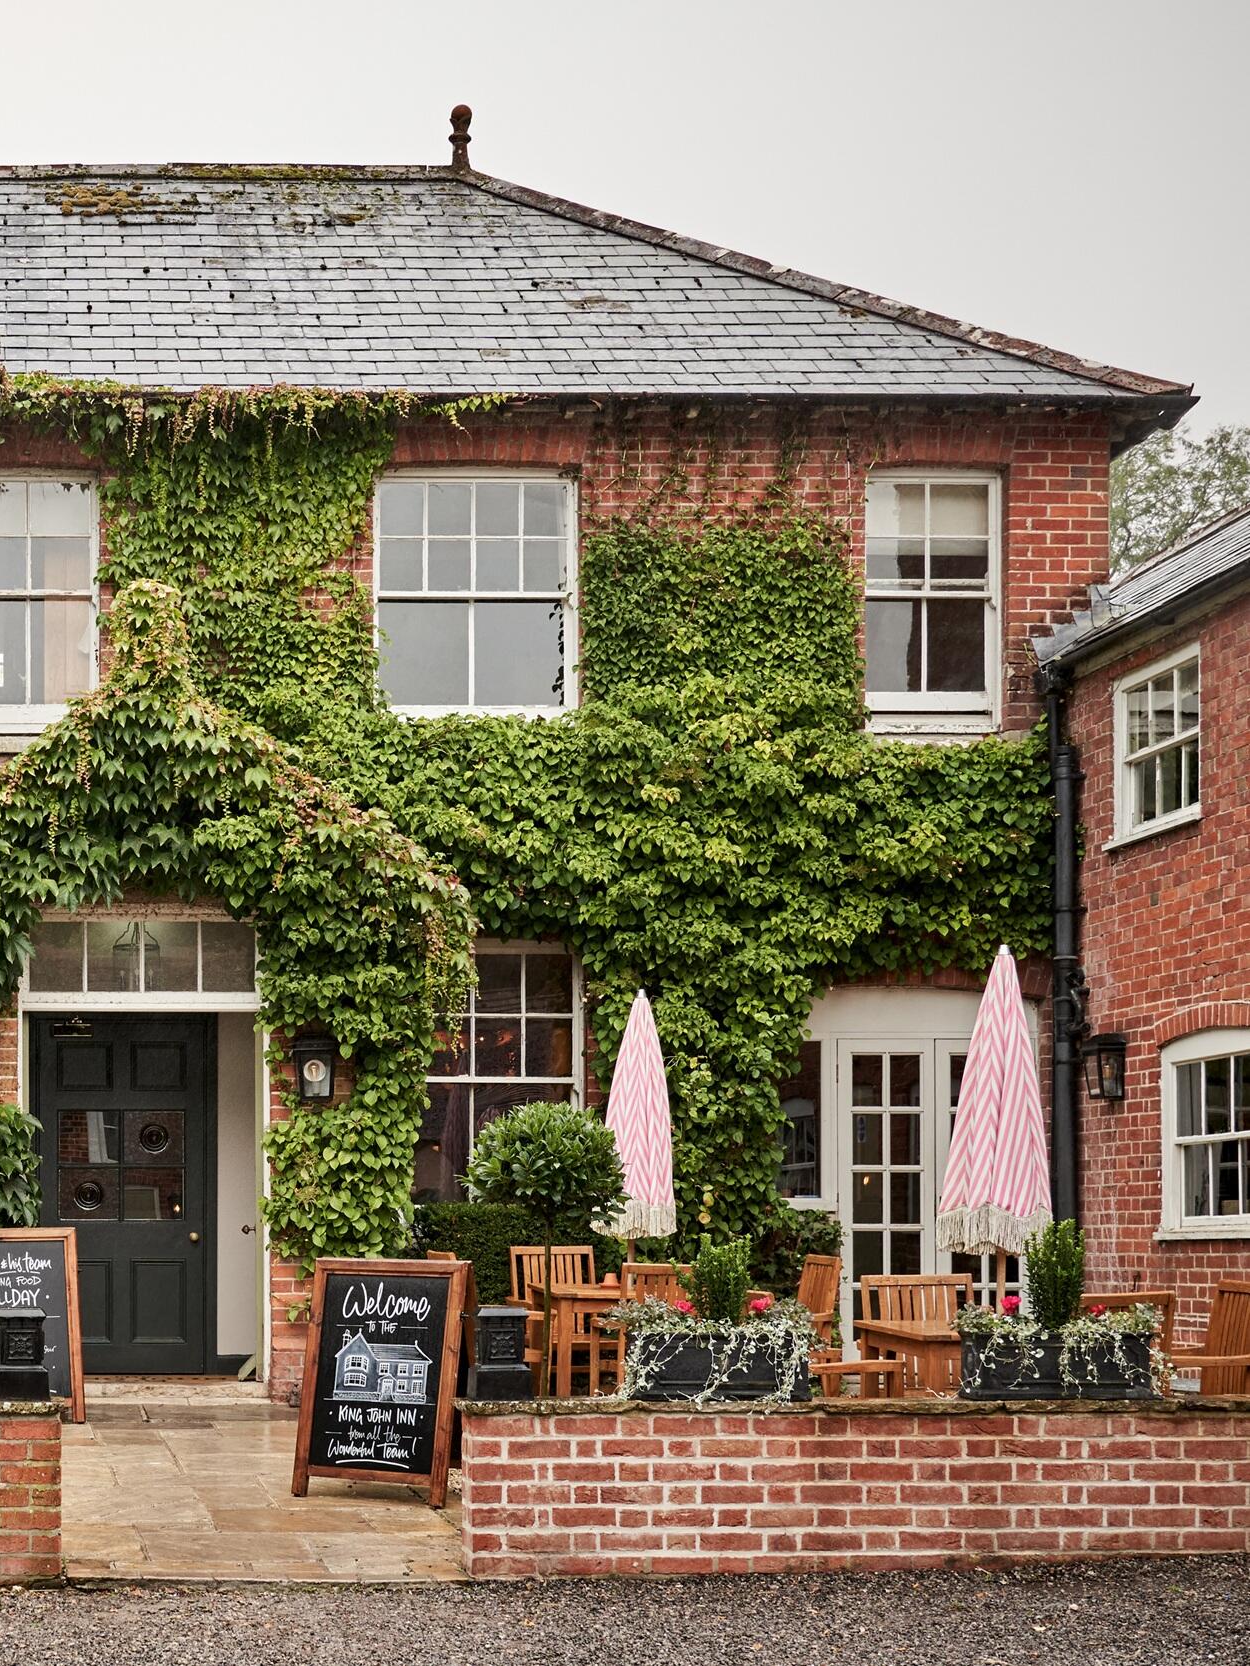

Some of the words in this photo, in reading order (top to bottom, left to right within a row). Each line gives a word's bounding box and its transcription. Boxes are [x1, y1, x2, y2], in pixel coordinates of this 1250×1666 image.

[8, 1252, 22, 1273] his
[22, 1251, 52, 1273] team
[15, 1275, 42, 1287] FOOD
[342, 1281, 431, 1322] Welcome
[378, 1320, 398, 1335] THE
[338, 1405, 363, 1426] KING
[366, 1407, 392, 1424] JOHN
[396, 1407, 417, 1426] INN
[366, 1425, 381, 1441] all
[383, 1425, 401, 1444] the
[327, 1438, 376, 1458] Wonderful
